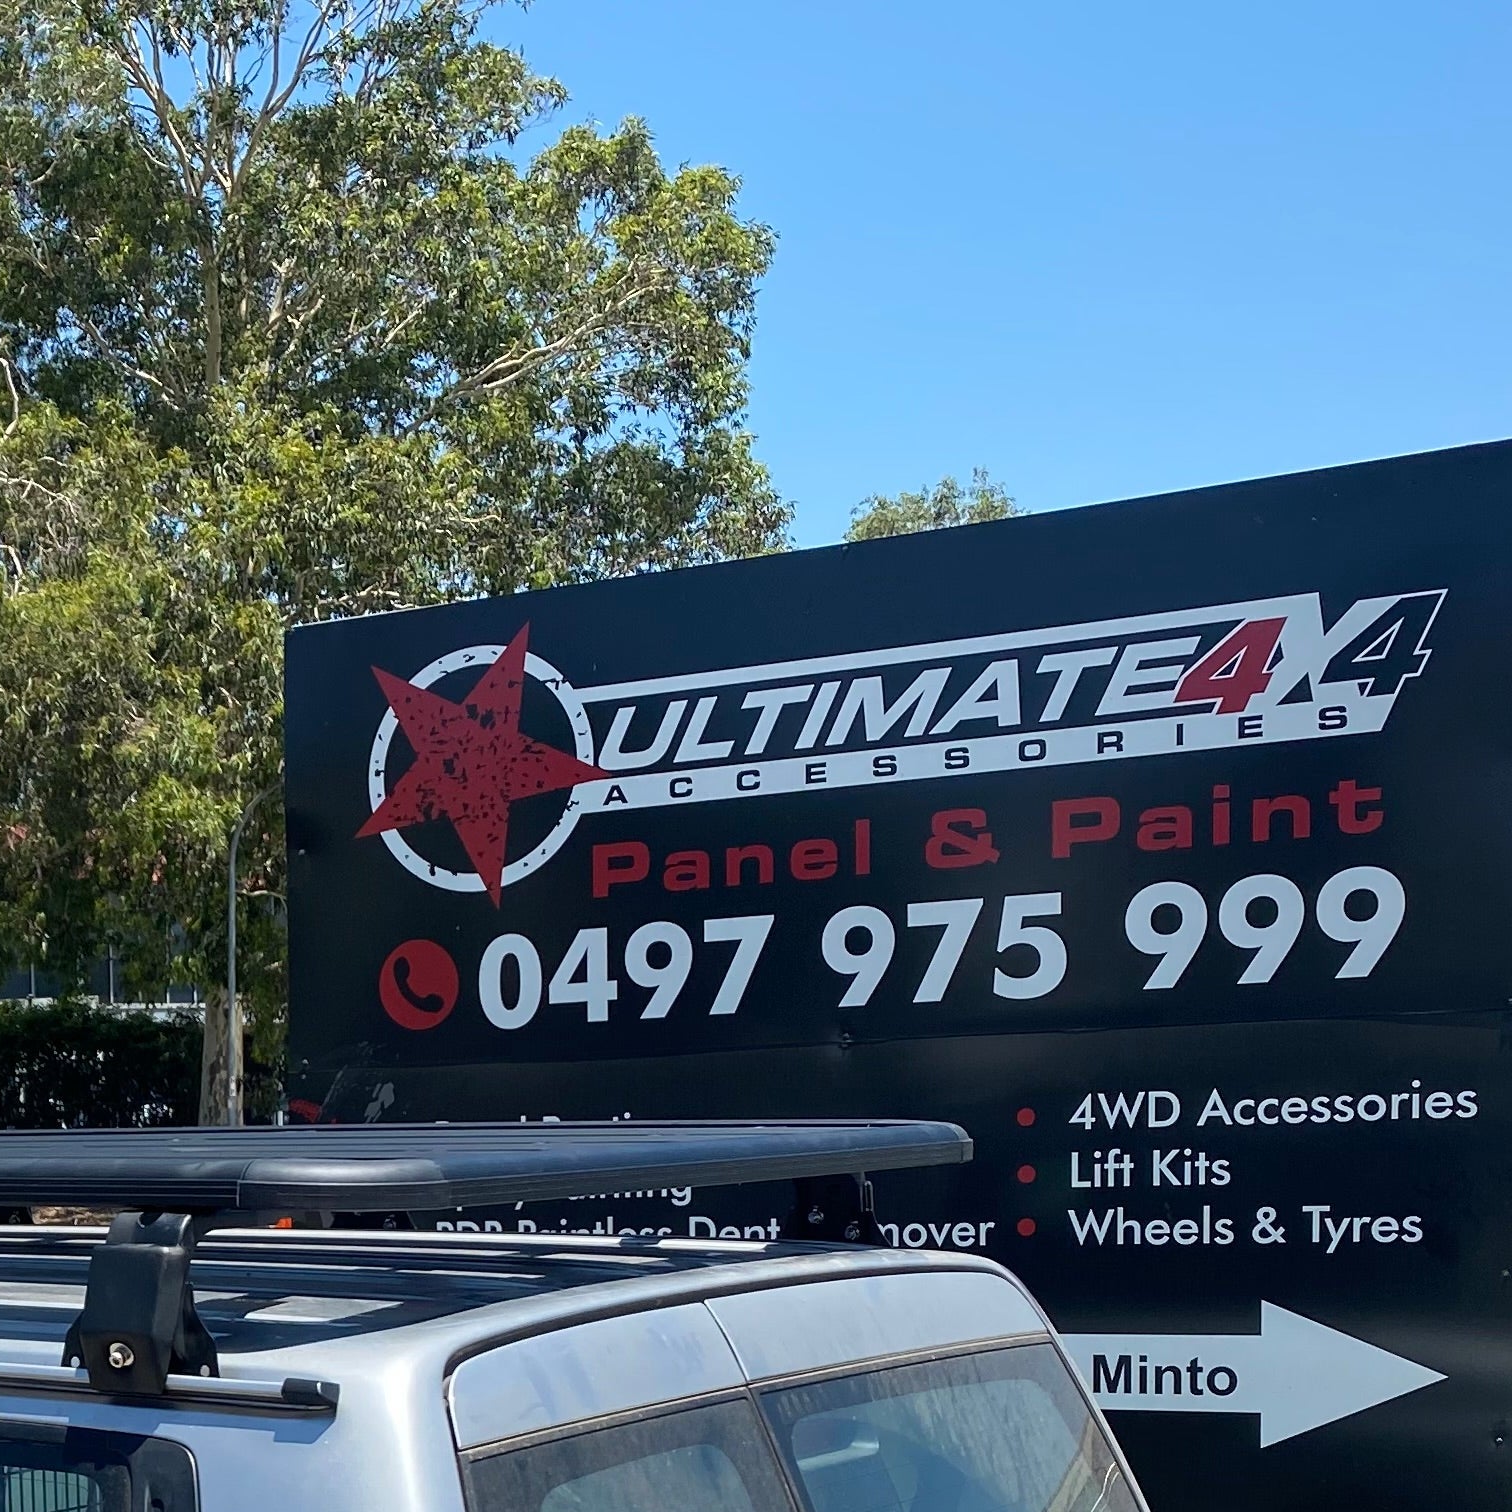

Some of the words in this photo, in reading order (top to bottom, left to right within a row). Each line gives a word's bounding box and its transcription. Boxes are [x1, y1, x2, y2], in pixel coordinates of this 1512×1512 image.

[602, 704, 1348, 806] ACCESSORIES
[593, 822, 870, 897] Panel
[926, 809, 998, 867] &
[1052, 780, 1384, 856] Paint
[478, 914, 775, 1030] 0497
[821, 891, 1068, 1008] 975
[1124, 865, 1406, 990] 999
[1068, 1090, 1181, 1130] 4WD
[1196, 1079, 1478, 1127] Accessories
[1071, 1148, 1135, 1188] Lift
[1152, 1148, 1231, 1187] Kits
[1067, 1205, 1235, 1246] Wheels
[1251, 1206, 1287, 1245] &
[1302, 1205, 1423, 1254] Tyres
[1092, 1354, 1238, 1397] Minto
